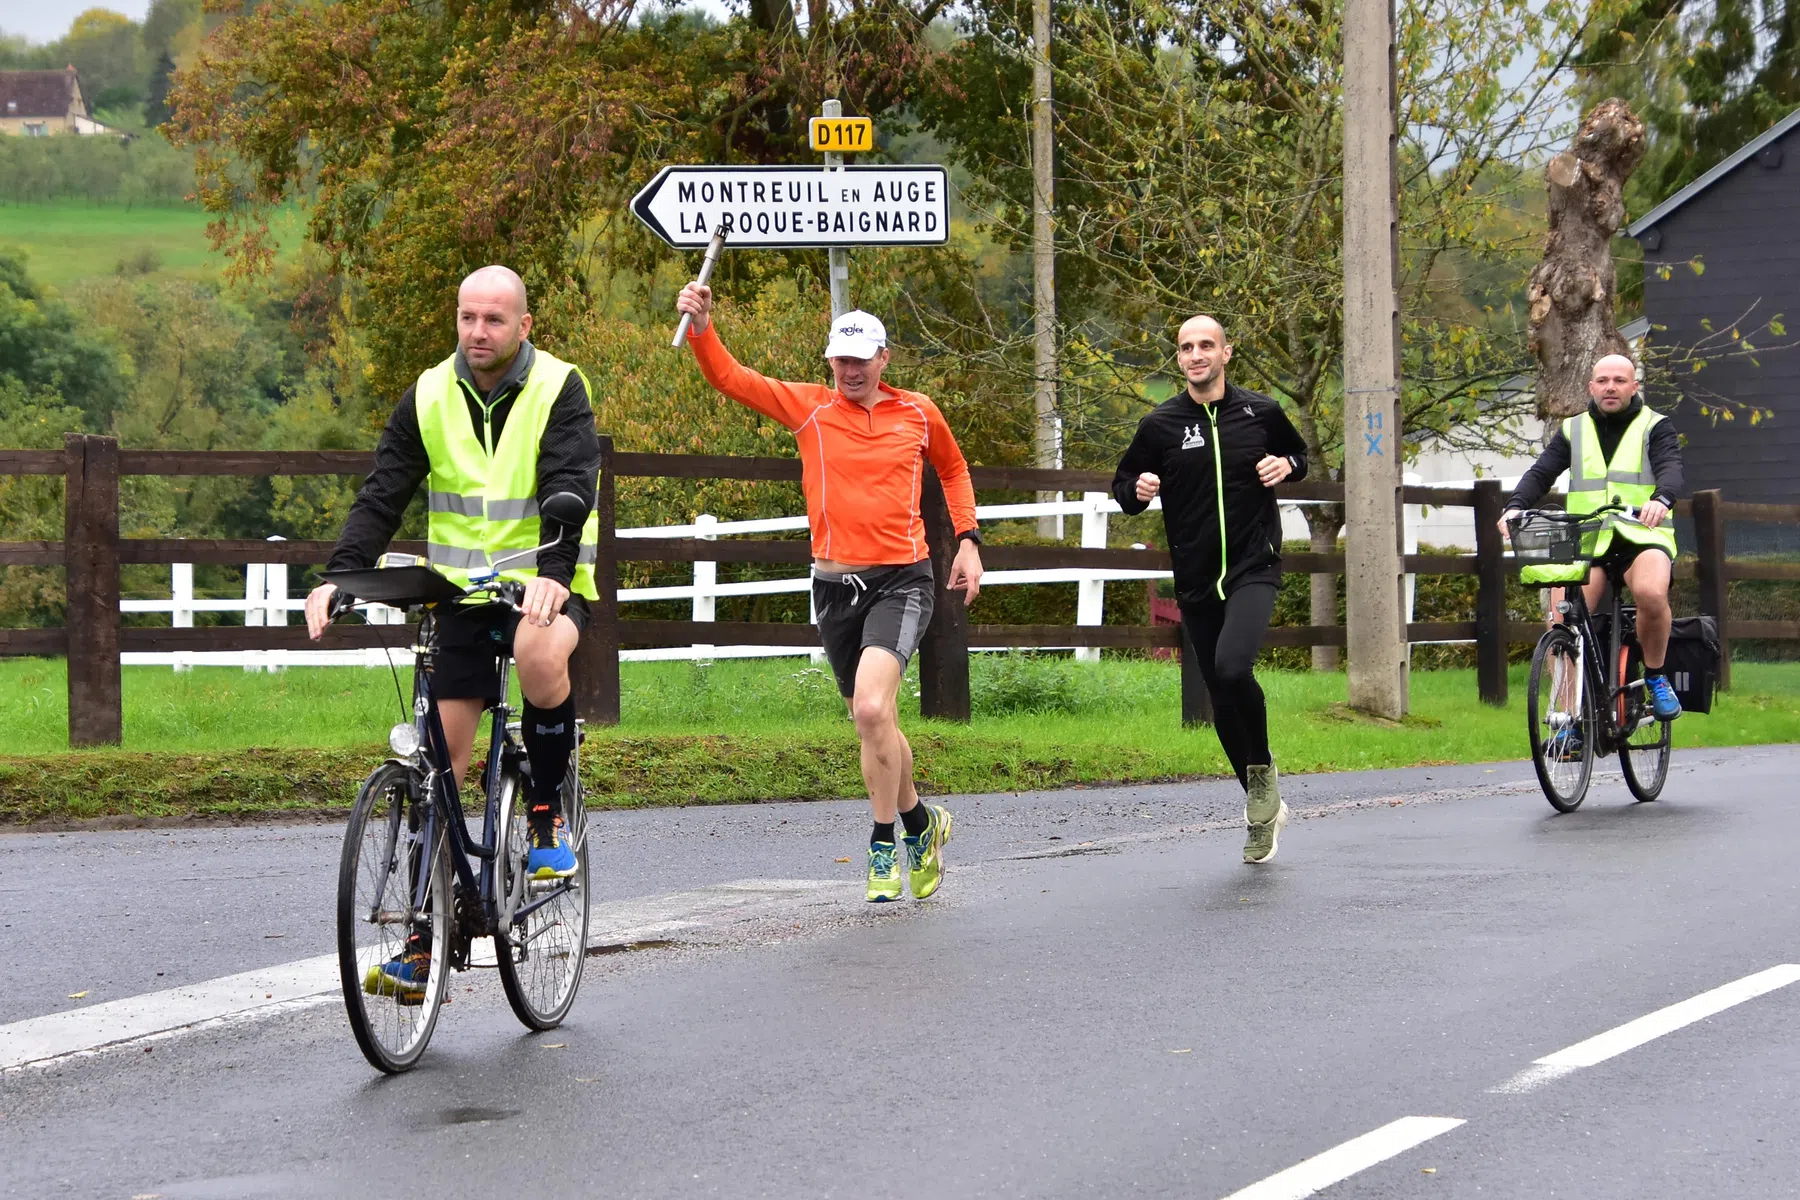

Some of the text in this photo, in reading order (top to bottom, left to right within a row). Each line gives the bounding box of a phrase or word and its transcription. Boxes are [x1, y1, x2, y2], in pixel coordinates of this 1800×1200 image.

[818, 124, 866, 145] D 117
[678, 181, 937, 203] MONTREUIL EN AUGE
[680, 211, 938, 234] LA ROQUE-BAIGNARD
[1364, 412, 1383, 430] 11
